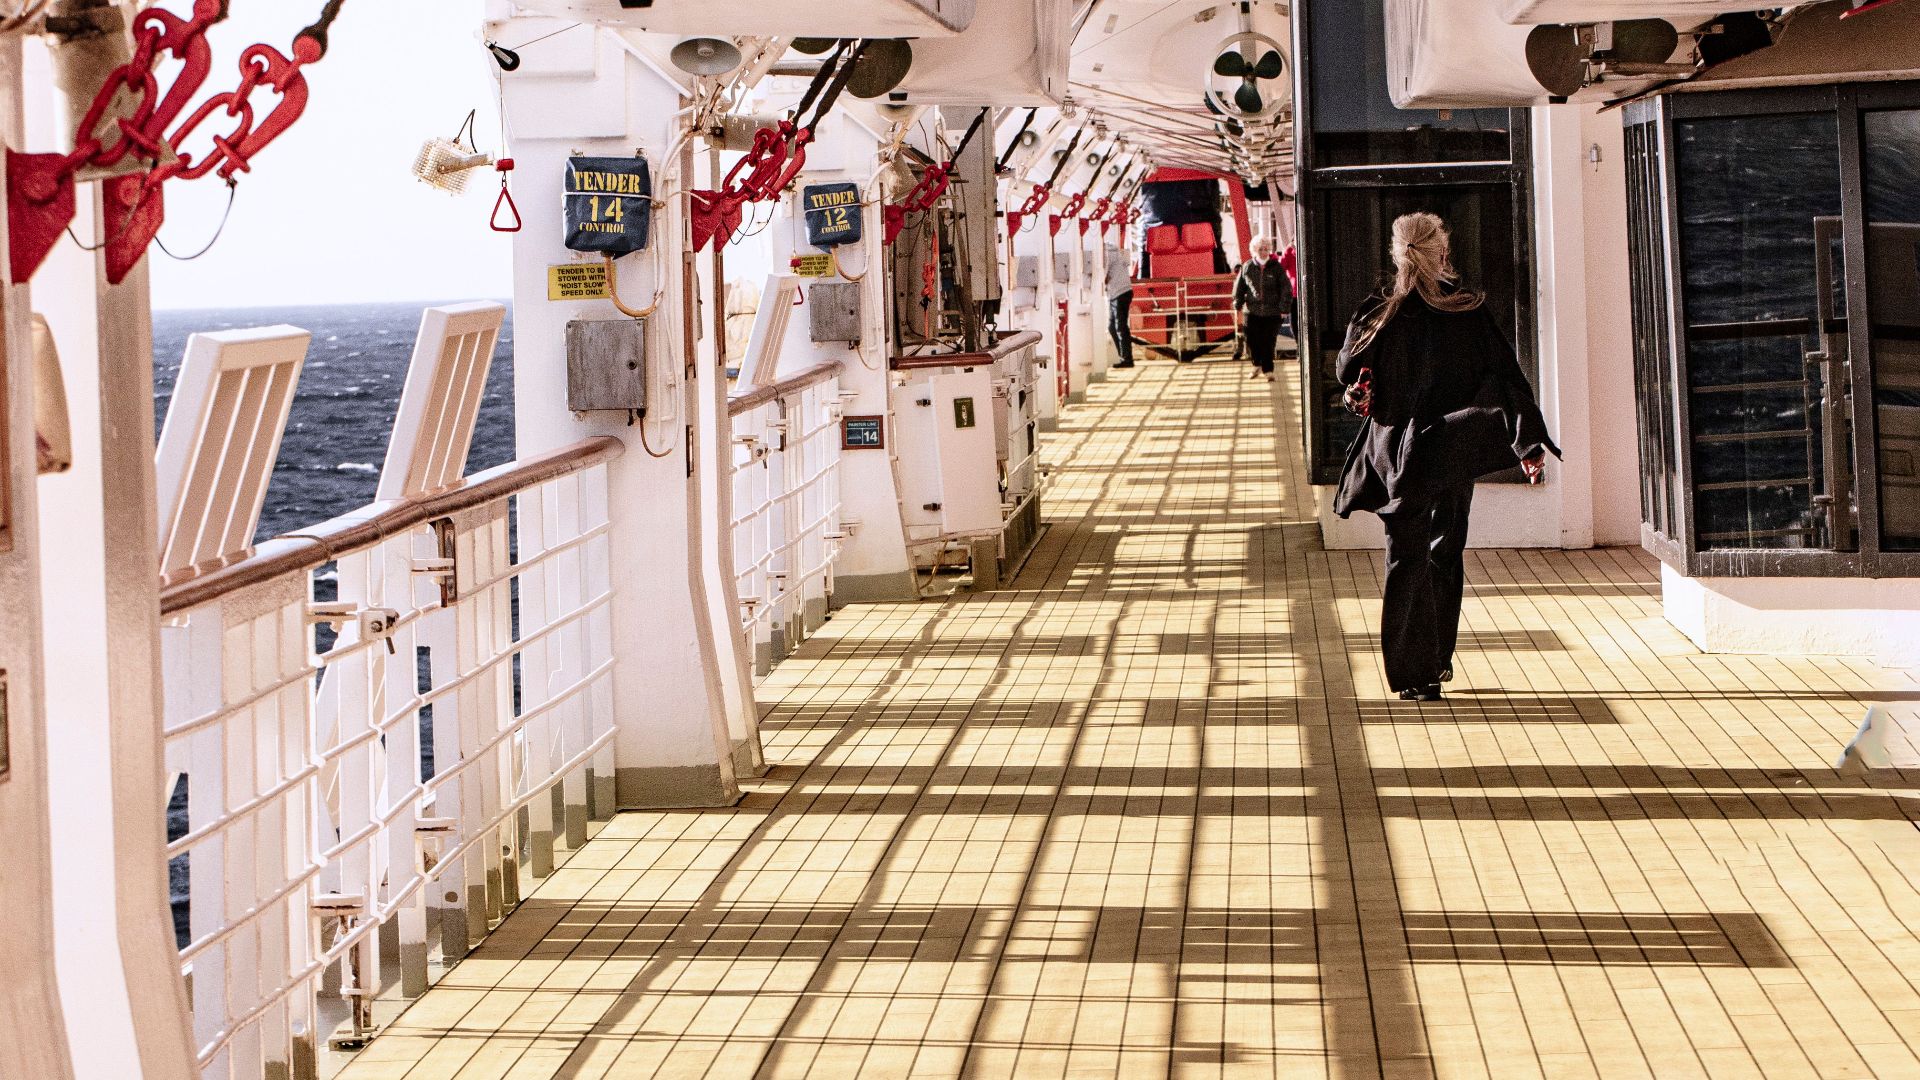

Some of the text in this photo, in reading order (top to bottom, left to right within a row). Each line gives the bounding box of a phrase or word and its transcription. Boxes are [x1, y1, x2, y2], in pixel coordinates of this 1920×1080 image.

[574, 171, 641, 194] TENDER
[811, 191, 855, 208] TENDER
[590, 196, 624, 222] 14
[825, 207, 848, 226] 12
[579, 222, 626, 234] CONTROL
[821, 224, 851, 234] CONTROL
[561, 289, 584, 297] SPEED
[863, 430, 878, 442] 14
